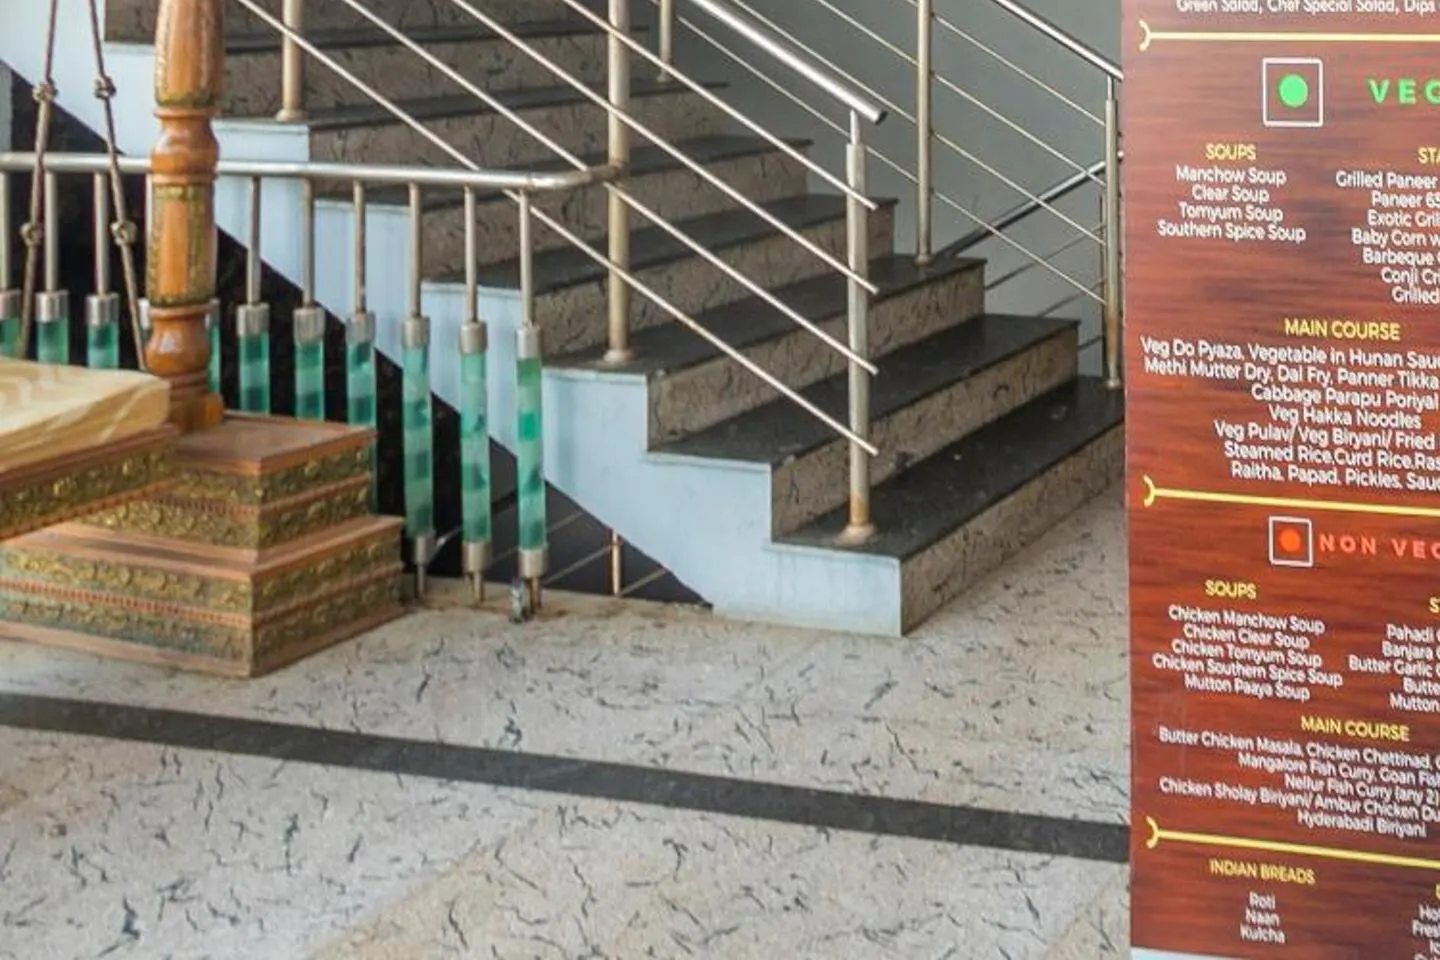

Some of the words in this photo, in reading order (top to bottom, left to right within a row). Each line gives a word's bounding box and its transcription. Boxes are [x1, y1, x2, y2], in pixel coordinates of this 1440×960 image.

[1205, 143, 1256, 161] SOUPS
[1176, 165, 1245, 183] Manchow
[1249, 167, 1287, 187] Soup
[1335, 170, 1383, 187] Grilled
[1386, 171, 1438, 189] Paneer
[1192, 185, 1228, 201] Clear
[1232, 186, 1269, 204] Soup
[1371, 191, 1422, 209] Paneer
[1179, 202, 1242, 223] Tomyum
[1245, 205, 1283, 224] Soup
[1367, 209, 1411, 228] Exotic
[1158, 219, 1222, 238] Southern
[1225, 222, 1265, 242] Spice
[1268, 224, 1306, 244] Soup
[1351, 228, 1389, 249] Baby
[1391, 229, 1425, 246] Corn
[1362, 248, 1434, 269] Barbeque
[1391, 286, 1440, 305] Grilled
[1284, 318, 1327, 337] MAIN
[1332, 320, 1400, 340] COURSE
[1140, 336, 1170, 358] Veg
[1173, 339, 1194, 356] Do
[1248, 343, 1327, 365] Vegetable
[1349, 348, 1402, 367] Hunan
[1144, 357, 1187, 376] Methi
[1190, 359, 1241, 380] Mutter
[1278, 365, 1302, 383] Dal
[1397, 371, 1439, 390] Tikka
[1251, 383, 1322, 404] Cabbage
[1269, 404, 1299, 424] Veg
[1302, 406, 1352, 425] Hakka
[1356, 410, 1422, 430] Noodles
[1214, 420, 1244, 441] Veg
[1298, 425, 1328, 445] Veg
[1396, 431, 1435, 450] Fried
[1224, 441, 1293, 461] Steamed
[1319, 534, 1376, 556] NON
[1205, 579, 1256, 600] SOUPS
[1168, 605, 1221, 623] Chicken
[1223, 609, 1287, 630] Manchow
[1290, 616, 1325, 635] Soup
[1183, 623, 1235, 642] Chicken
[1238, 628, 1273, 645] Clear
[1275, 631, 1310, 651] Soup
[1172, 639, 1224, 658] Chicken
[1287, 650, 1322, 669] Soup
[1152, 654, 1204, 672] Chicken
[1269, 665, 1306, 684] Spice
[1308, 669, 1343, 688] Soup
[1349, 654, 1392, 673] Butter
[1393, 658, 1433, 677] Garlic
[1185, 674, 1232, 692] Mutton
[1275, 682, 1310, 702] Soup
[1389, 693, 1440, 714] Mutton
[1301, 715, 1341, 735] MAIN
[1345, 720, 1410, 741] COURSE
[1201, 730, 1254, 750] Chicken
[1306, 742, 1360, 762] Chicken
[1159, 776, 1212, 797] Chicken
[1363, 799, 1419, 820] Chicken
[1209, 858, 1258, 878] INDIAN
[1260, 863, 1316, 885] BREADS
